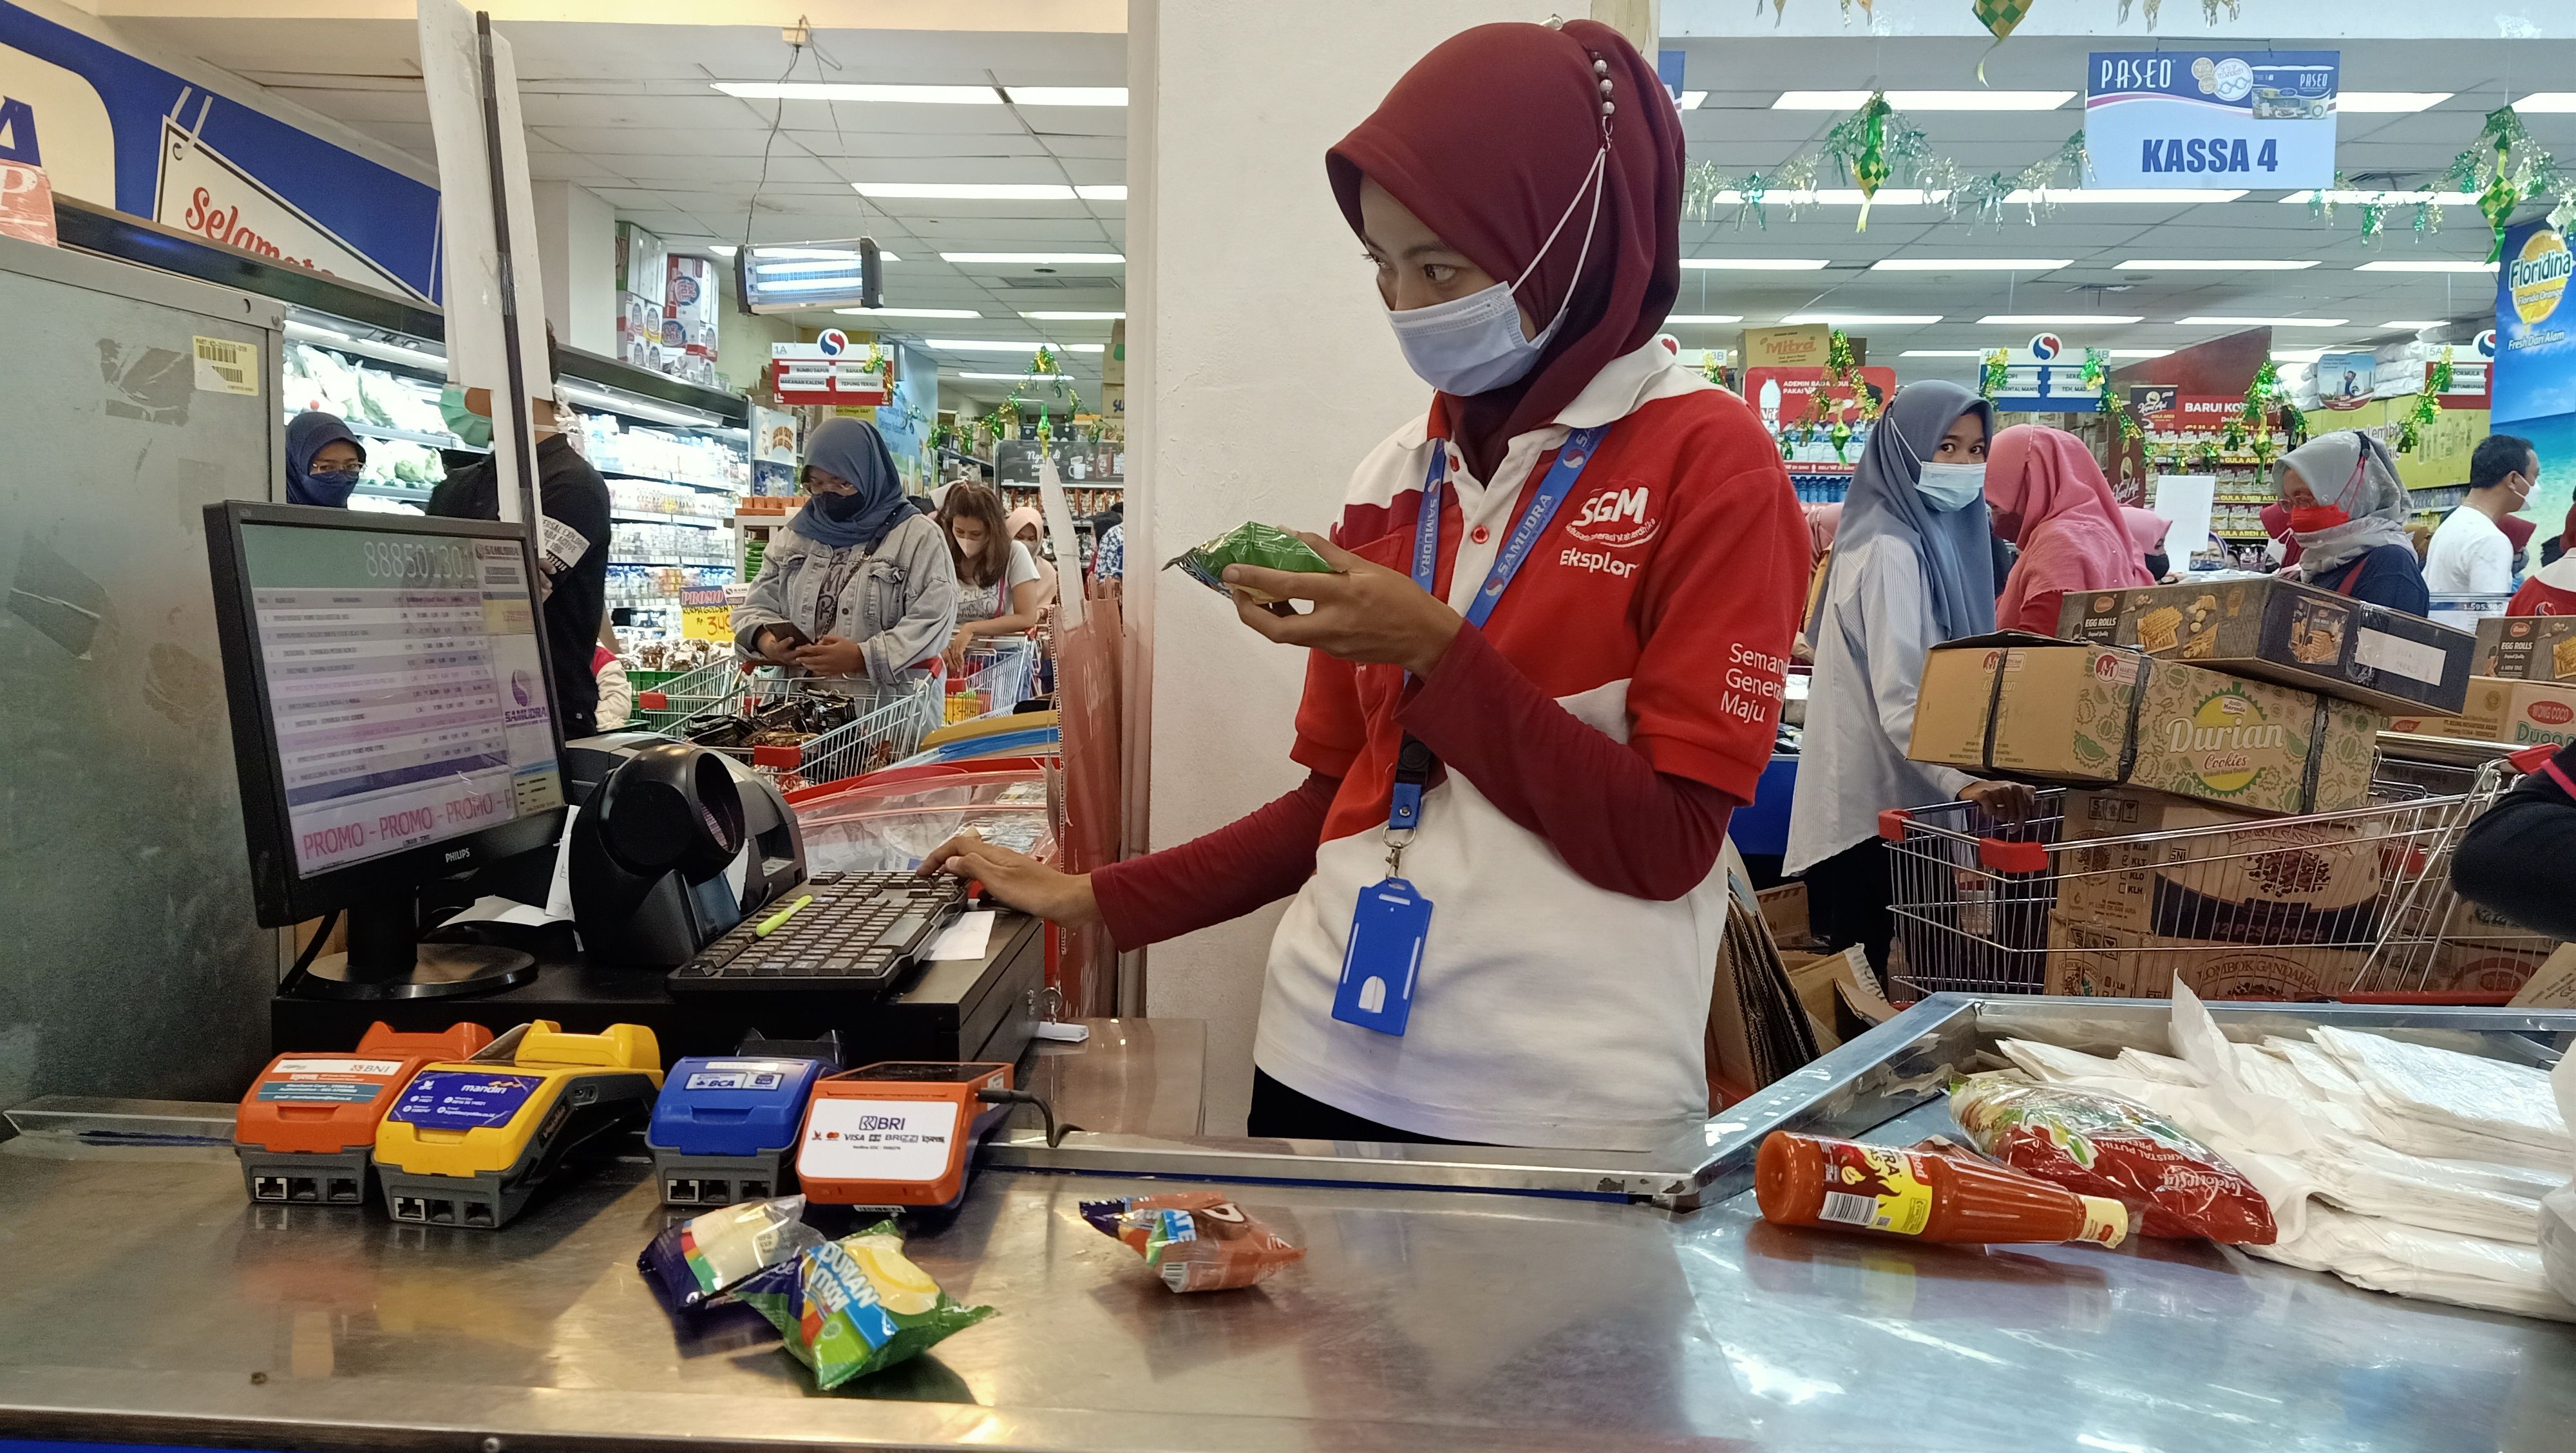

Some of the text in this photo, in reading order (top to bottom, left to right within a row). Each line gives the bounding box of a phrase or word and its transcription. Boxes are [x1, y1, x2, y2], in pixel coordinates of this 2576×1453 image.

[2101, 59, 2172, 89] PASEO
[2300, 73, 2328, 88] PASEO
[2142, 138, 2278, 173] KASSA 4
[2510, 251, 2571, 289] Floridina
[2517, 287, 2564, 306] Florida Orange
[1766, 337, 1817, 355] Mitra
[2508, 330, 2566, 351] Fresh Dari Alam
[774, 345, 787, 354] 1A
[1571, 486, 1649, 527] SGM
[1420, 497, 1438, 577] SAMUDRA
[1497, 493, 1553, 576] SAMUDRA
[1559, 547, 1640, 579] Eksplor
[681, 590, 724, 605] PROMO
[2085, 617, 2117, 628] EGG ROLLS
[2501, 641, 2533, 651] EGG ROLLS
[504, 707, 547, 723] SAMUDRA
[1720, 690, 1766, 724] Maju
[2550, 707, 2569, 720] COCO
[2164, 716, 2284, 754] Durian
[2204, 752, 2248, 770] Cookies
[303, 822, 365, 860] PROMO
[379, 806, 433, 841] PROMO
[446, 792, 493, 824] PROMO
[445, 848, 471, 863] PHILIPS
[2132, 843, 2149, 851] KLM
[2131, 857, 2146, 866] KLT
[2129, 872, 2145, 881] KLO
[2195, 959, 2254, 981] LOMBOK
[363, 1065, 392, 1074] BNI
[877, 1117, 906, 1130] BRI
[843, 1133, 865, 1142] VISA
[884, 1134, 919, 1143] BRIZZI
[2100, 1141, 2136, 1155] PUTIH
[2137, 1148, 2184, 1162] KRISTAL
[821, 1242, 883, 1309] DURIAN
